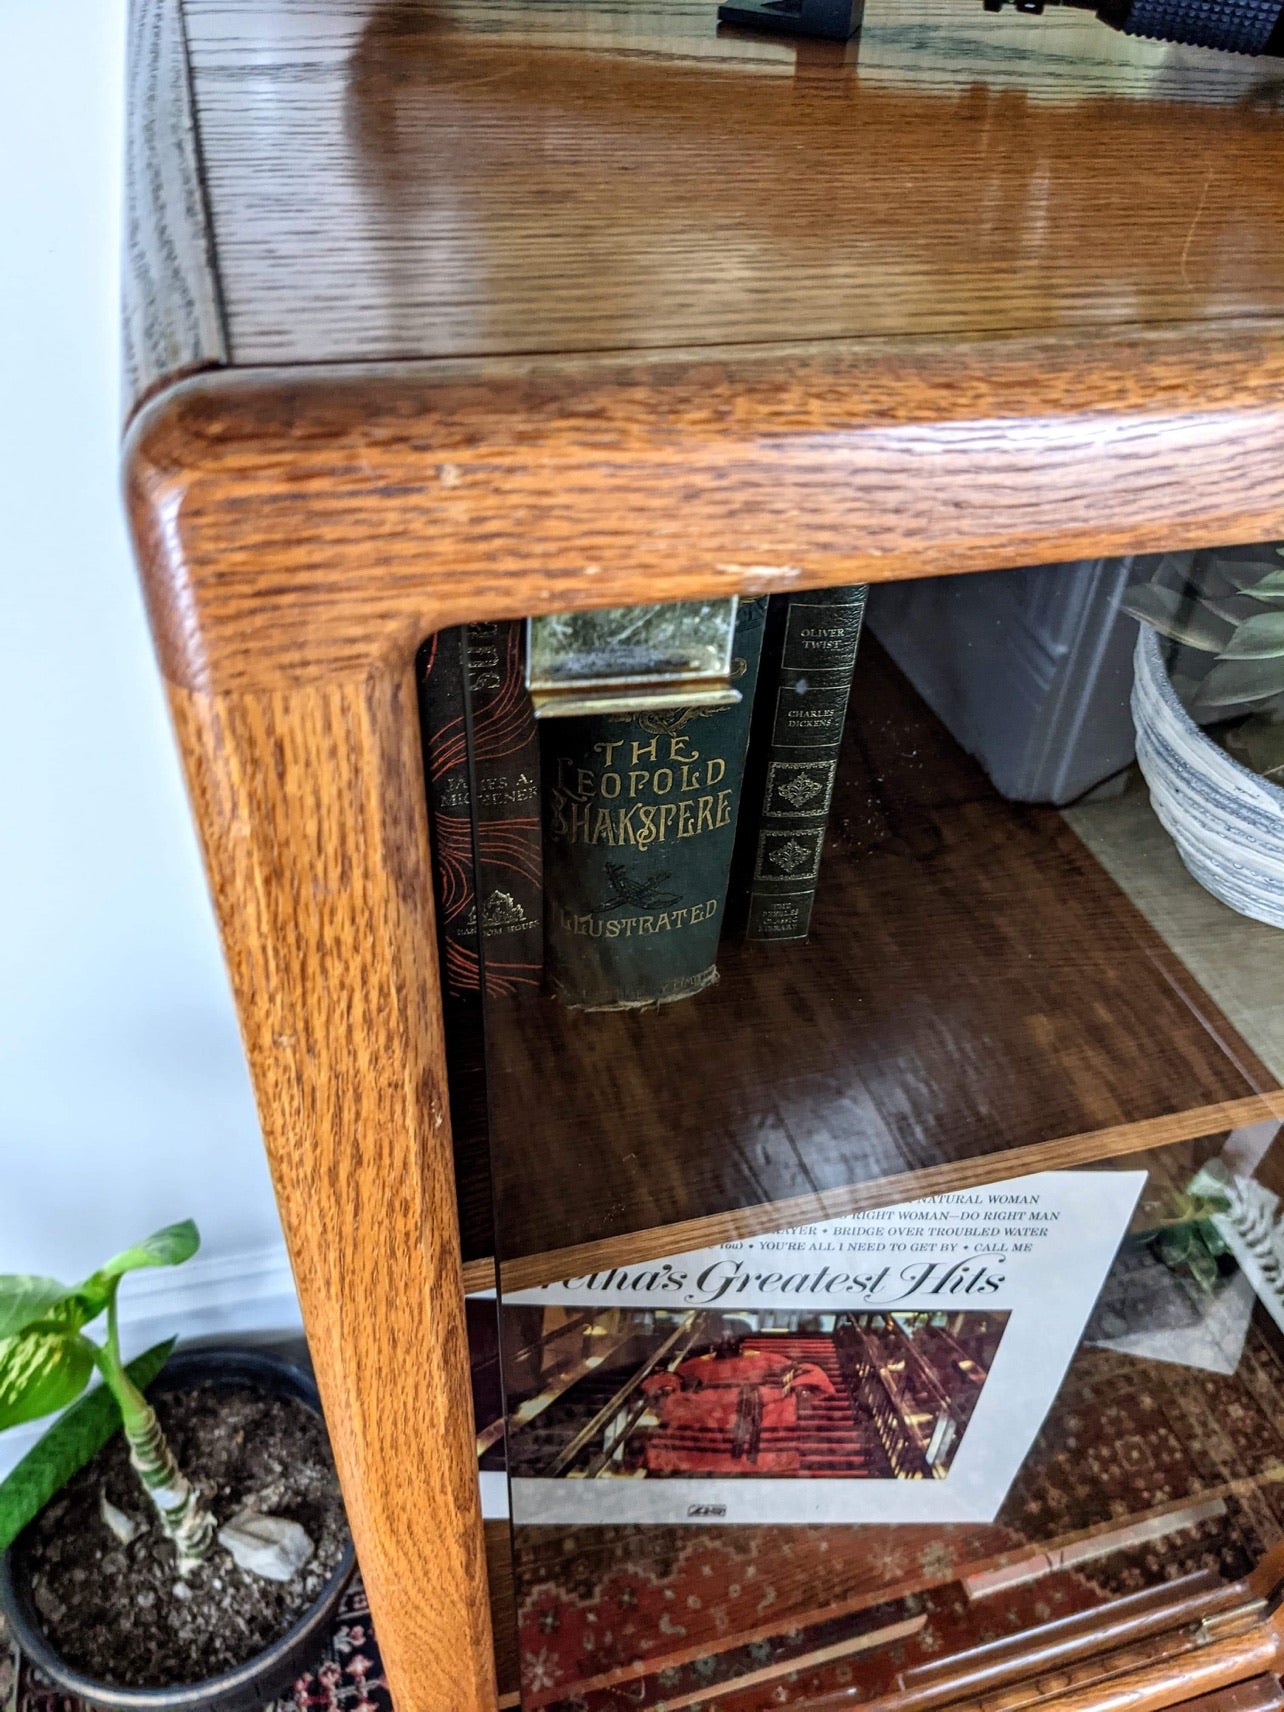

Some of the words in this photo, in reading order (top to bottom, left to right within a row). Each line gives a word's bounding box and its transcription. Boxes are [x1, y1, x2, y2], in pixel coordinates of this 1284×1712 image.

[800, 628, 845, 638] OLIVER
[802, 640, 842, 649] TWIST
[788, 709, 834, 718] CHARLES
[788, 719, 831, 727] DICKENS
[594, 735, 699, 767] THE
[445, 777, 508, 792] JAES
[557, 757, 726, 801] LEOPOLD
[552, 789, 733, 851] SHAKSPERE
[988, 1195, 1040, 1204] WOMAN
[983, 1211, 1026, 1221] RIGHT
[1028, 1211, 1060, 1221] MAN
[833, 1226, 885, 1236] BRIDGE
[888, 1226, 924, 1236] OVER
[928, 1227, 1000, 1237] TROUBLED
[1004, 1227, 1048, 1237] WATER
[759, 1241, 806, 1251] YOU'RE
[809, 1242, 835, 1251] ALL
[838, 1242, 844, 1251] I
[847, 1242, 886, 1252] NEED
[889, 1242, 907, 1252] TO
[910, 1242, 937, 1252] GET
[940, 1242, 958, 1252] BY
[974, 1243, 1009, 1252] CALL
[1012, 1243, 1033, 1252] ME
[684, 1260, 890, 1304] Greatest
[863, 1253, 1006, 1304] Hits
